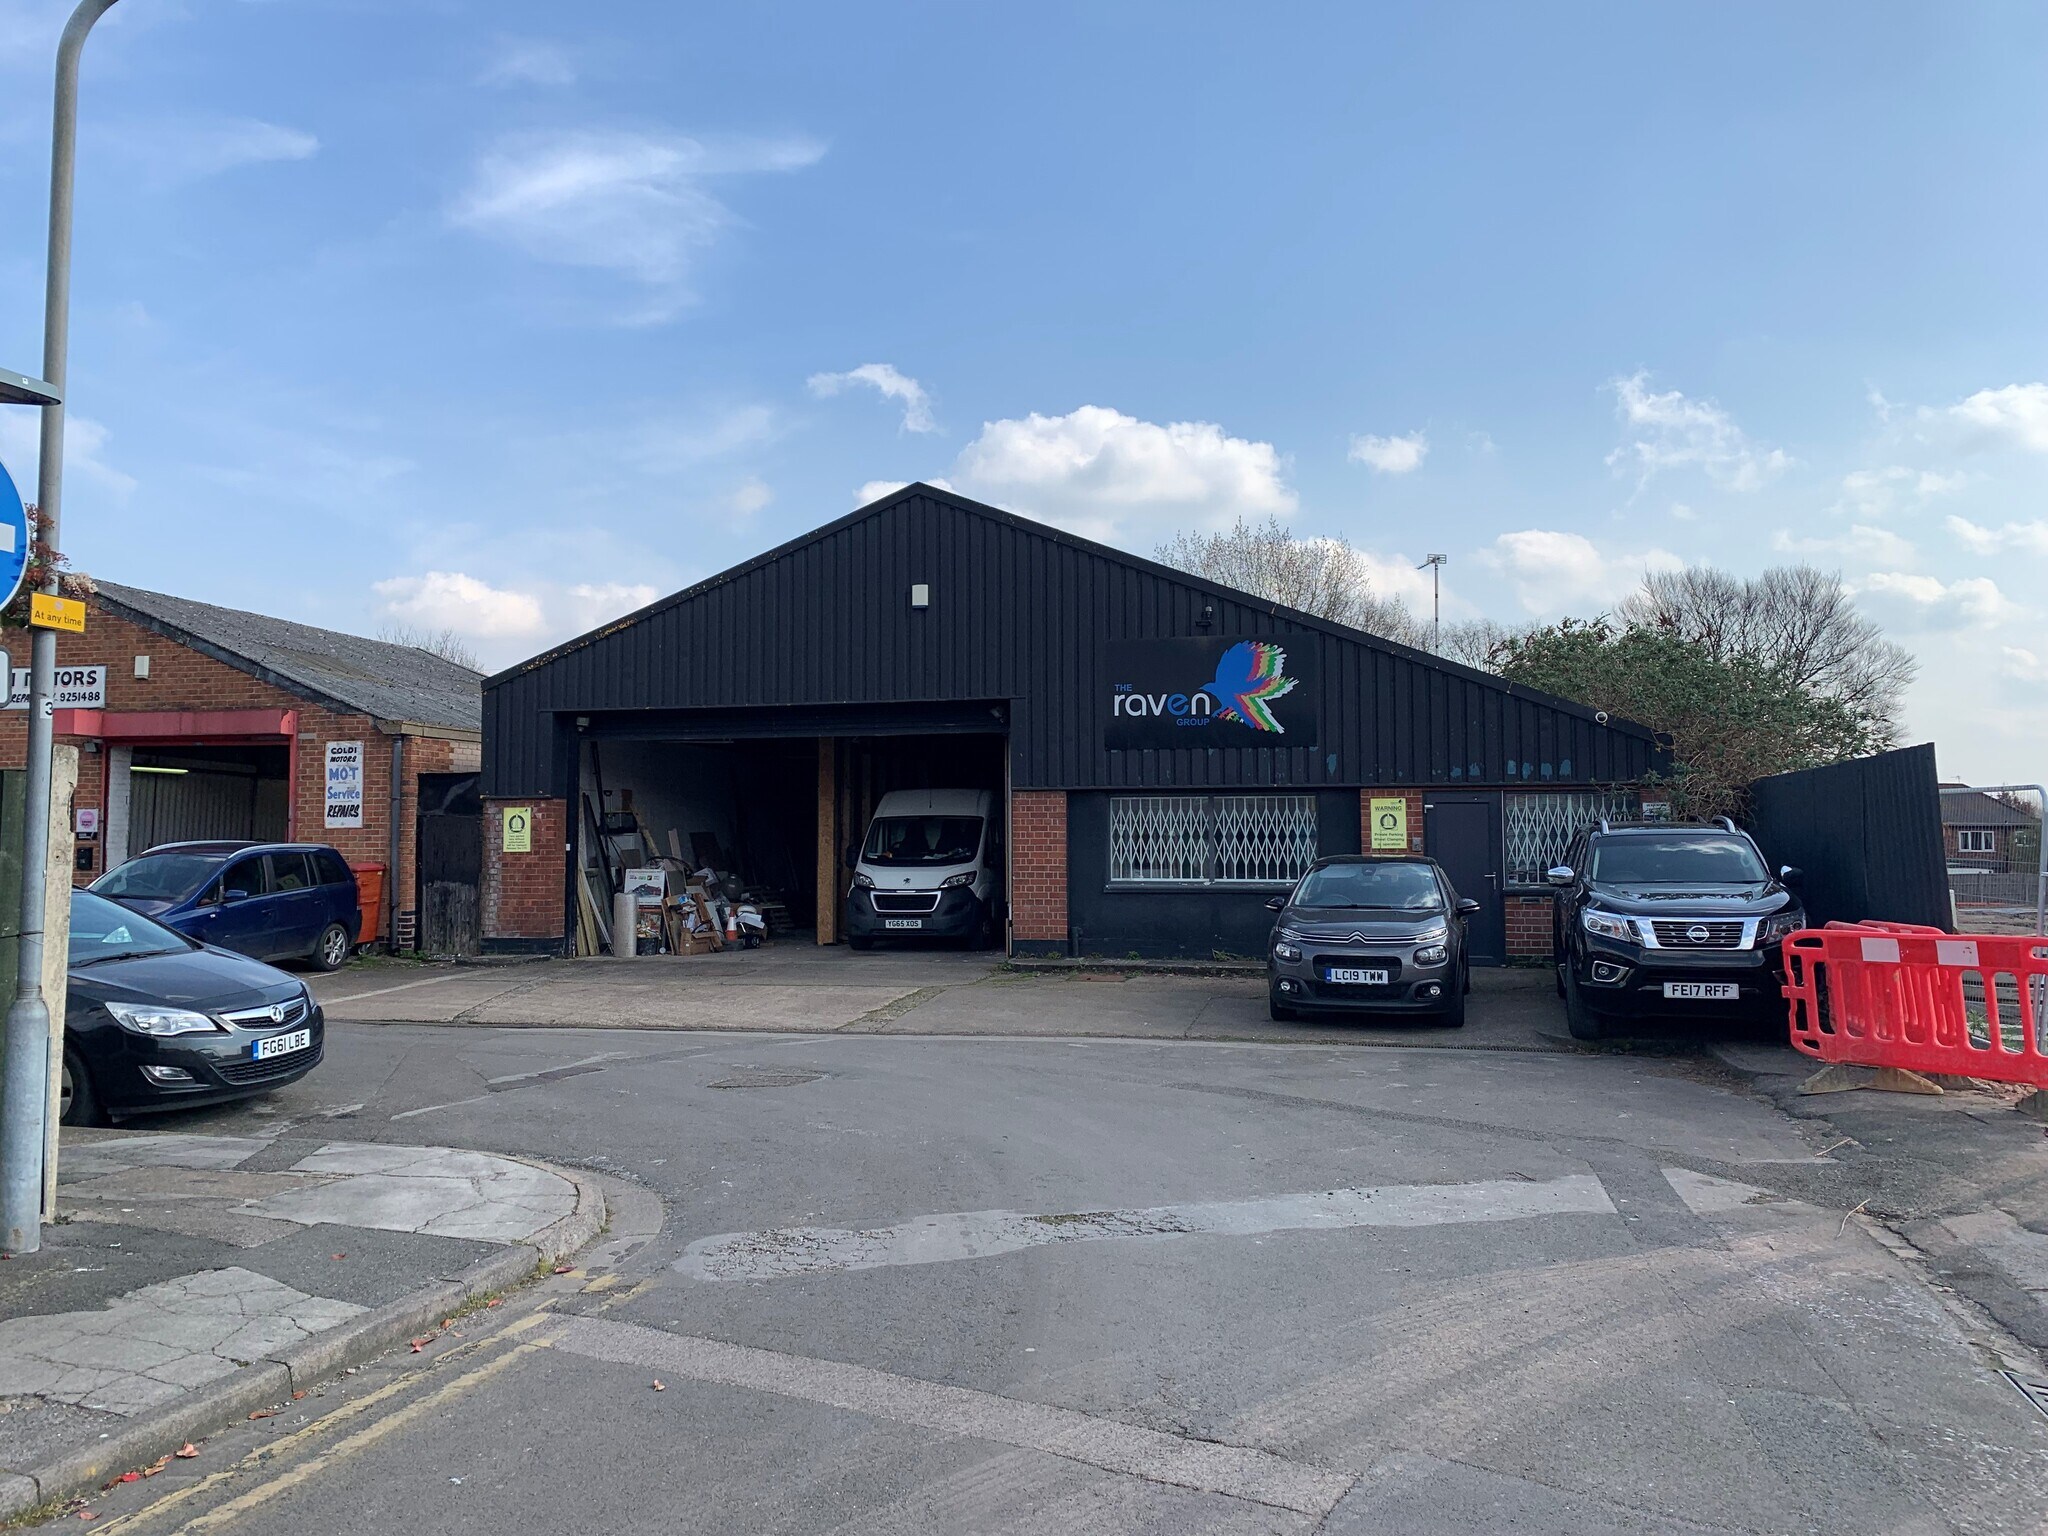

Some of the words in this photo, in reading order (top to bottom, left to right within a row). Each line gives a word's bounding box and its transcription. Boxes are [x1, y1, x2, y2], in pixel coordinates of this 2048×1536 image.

[34, 610, 45, 620] At
[46, 614, 62, 624] any
[64, 614, 82, 626] time
[1114, 683, 1133, 692] THE
[59, 691, 101, 702] 9251488
[1114, 692, 1211, 717] raven
[1176, 718, 1210, 726] GROUP
[330, 746, 358, 755] COLDI
[329, 755, 358, 763] MOTORS
[328, 767, 359, 781] MOT
[327, 785, 360, 800] Service
[326, 804, 360, 818] REPAIRS
[1335, 970, 1360, 981] LC19
[1362, 971, 1384, 982] TWW
[1672, 984, 1701, 996] FE17
[1704, 985, 1731, 997] RFF
[262, 1037, 288, 1056] FG61
[288, 1032, 306, 1049] LBE
